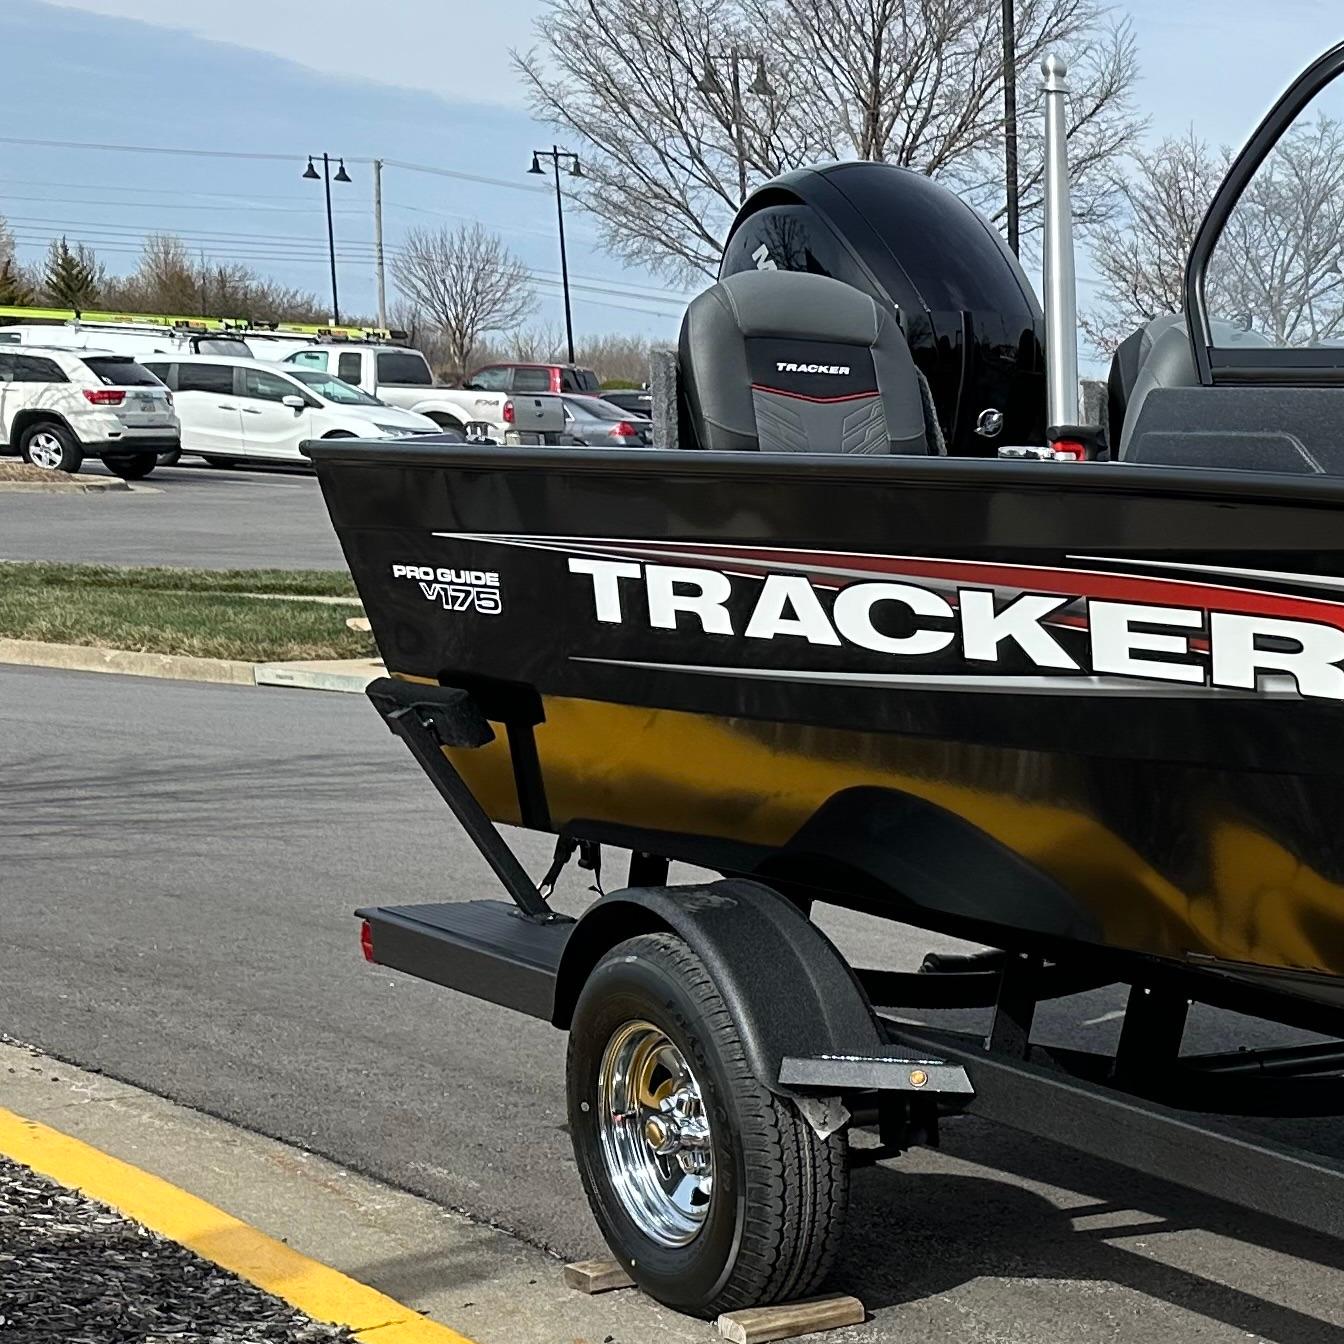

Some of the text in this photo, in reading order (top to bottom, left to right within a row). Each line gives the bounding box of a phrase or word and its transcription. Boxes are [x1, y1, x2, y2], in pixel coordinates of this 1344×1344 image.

[776, 362, 850, 375] TRACKER
[392, 564, 500, 587] PRO GUIDE
[418, 581, 502, 615] V175
